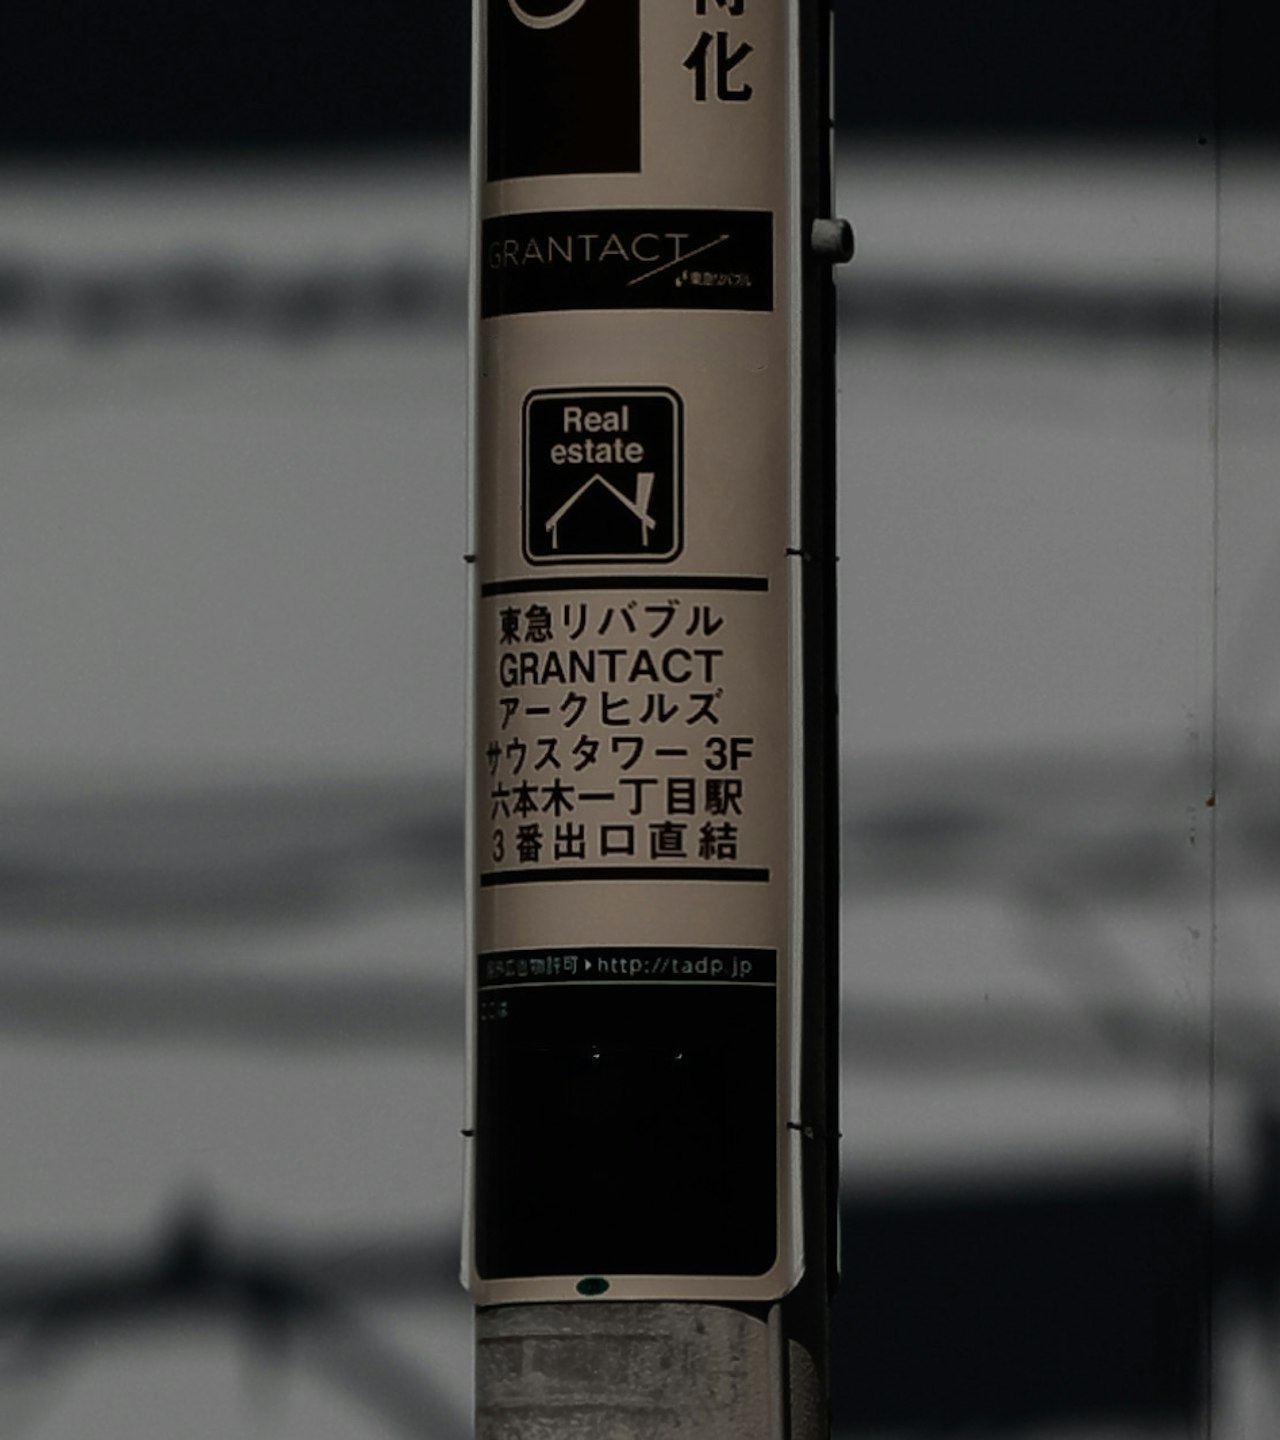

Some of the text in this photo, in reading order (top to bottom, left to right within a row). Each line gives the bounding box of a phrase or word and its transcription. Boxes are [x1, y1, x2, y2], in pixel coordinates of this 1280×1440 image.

[684, 0, 752, 101] 化
[488, 232, 690, 271] GRANTACT
[562, 404, 630, 433] Real
[549, 437, 646, 466] estate
[499, 600, 724, 645] 東急リバブル
[499, 648, 724, 688] GRANTACT
[499, 688, 724, 730] アークヒルズ
[490, 778, 743, 820] 六本木一丁目駅
[491, 821, 738, 864] 3番出口直結
